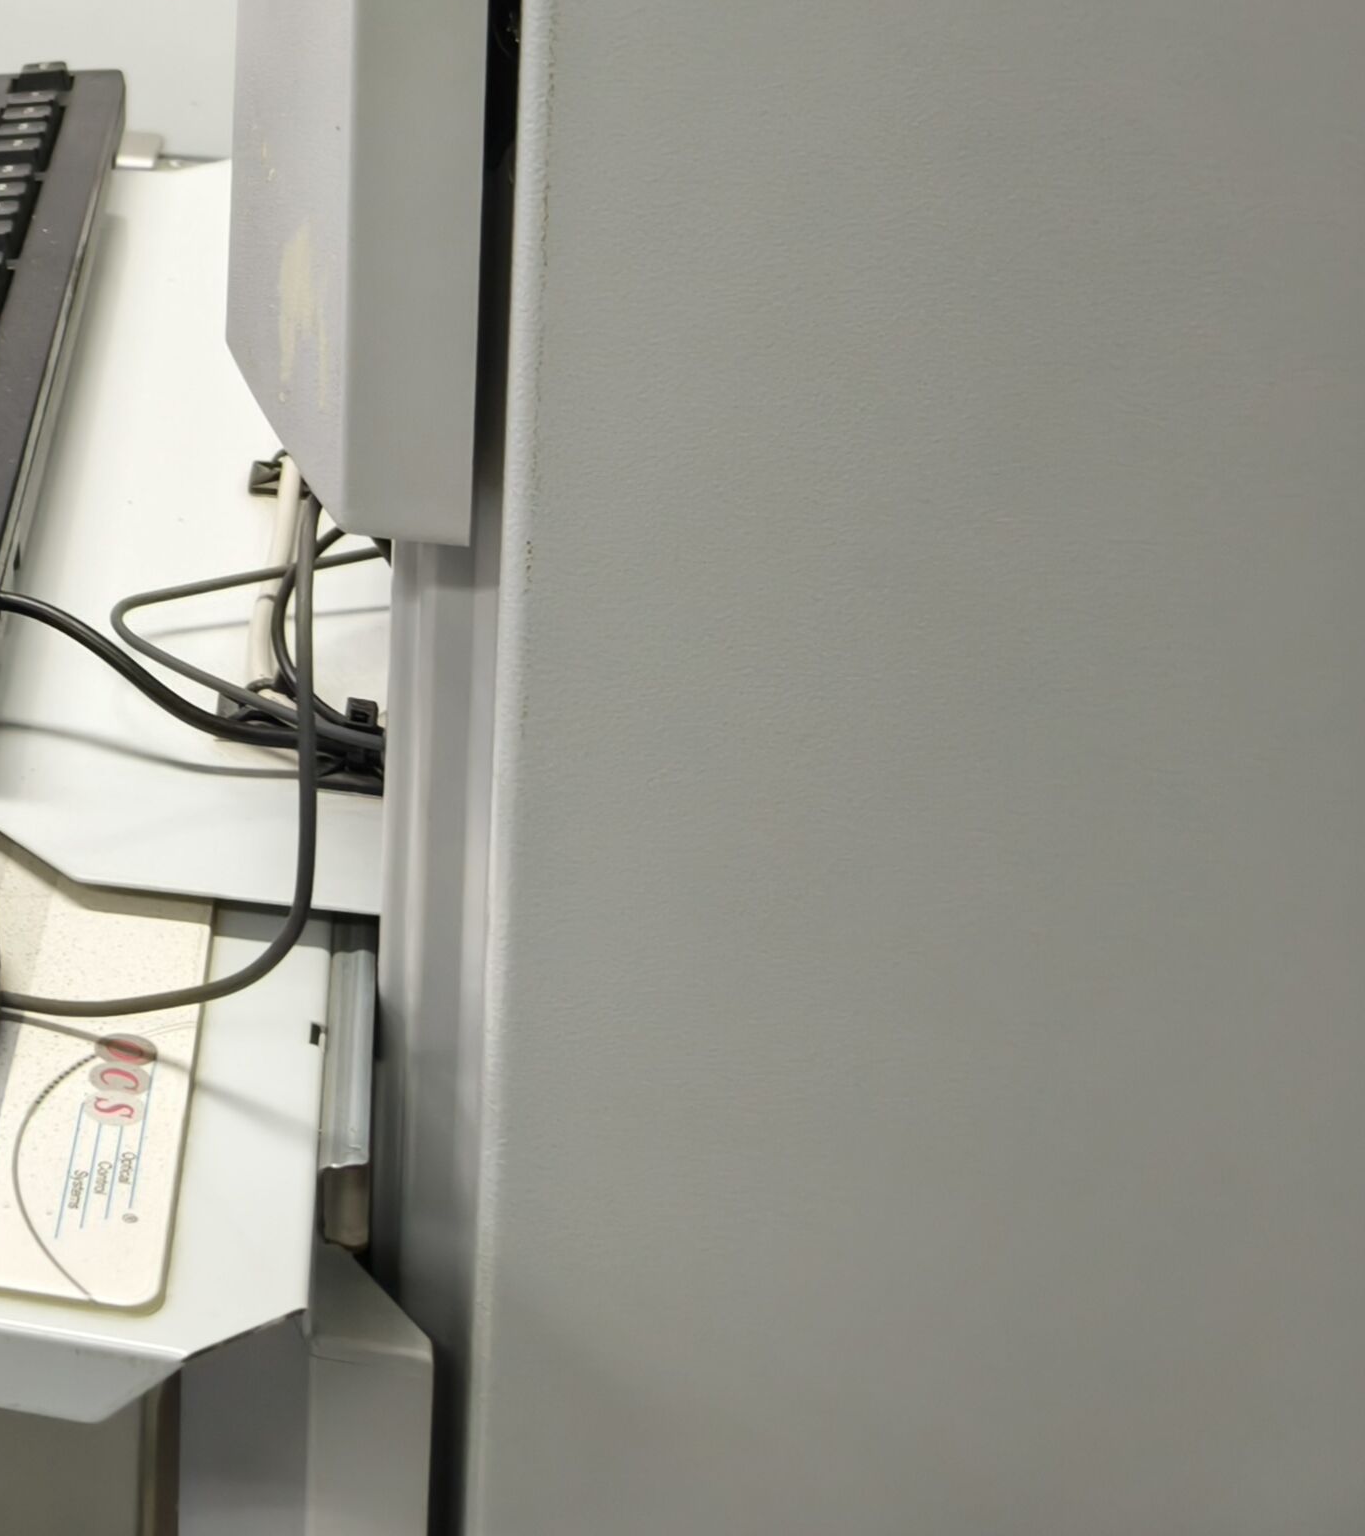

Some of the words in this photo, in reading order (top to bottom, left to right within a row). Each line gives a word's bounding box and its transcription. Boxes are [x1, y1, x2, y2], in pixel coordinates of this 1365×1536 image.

[93, 1039, 144, 1121] OCS
[94, 1160, 113, 1196] Control
[117, 1151, 137, 1185] Optical
[67, 1168, 88, 1210] Systems
